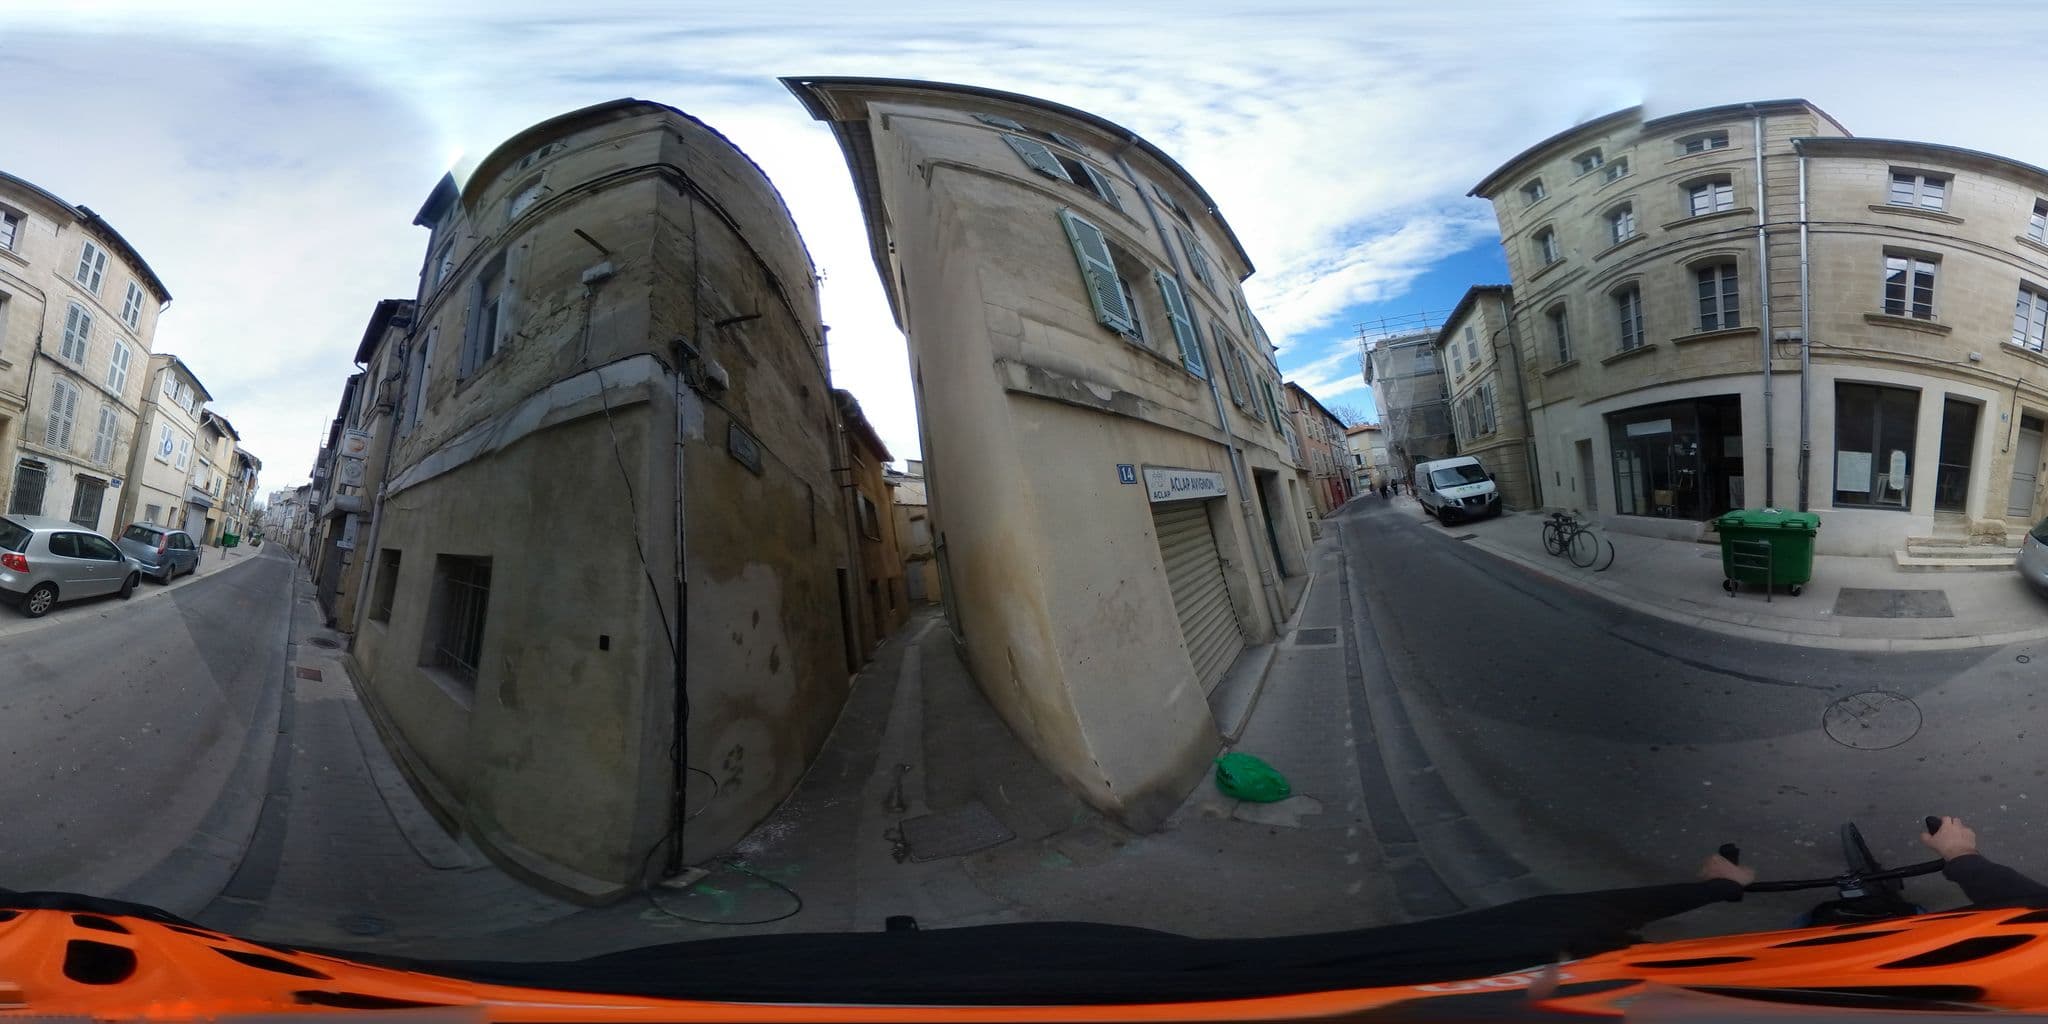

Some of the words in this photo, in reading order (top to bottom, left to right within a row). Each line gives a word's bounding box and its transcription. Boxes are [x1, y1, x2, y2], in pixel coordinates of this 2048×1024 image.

[1121, 467, 1133, 481] 14
[1170, 477, 1190, 491] ACLAP
[1191, 478, 1214, 490] AVIGNON
[1153, 491, 1171, 499] ACLAP
